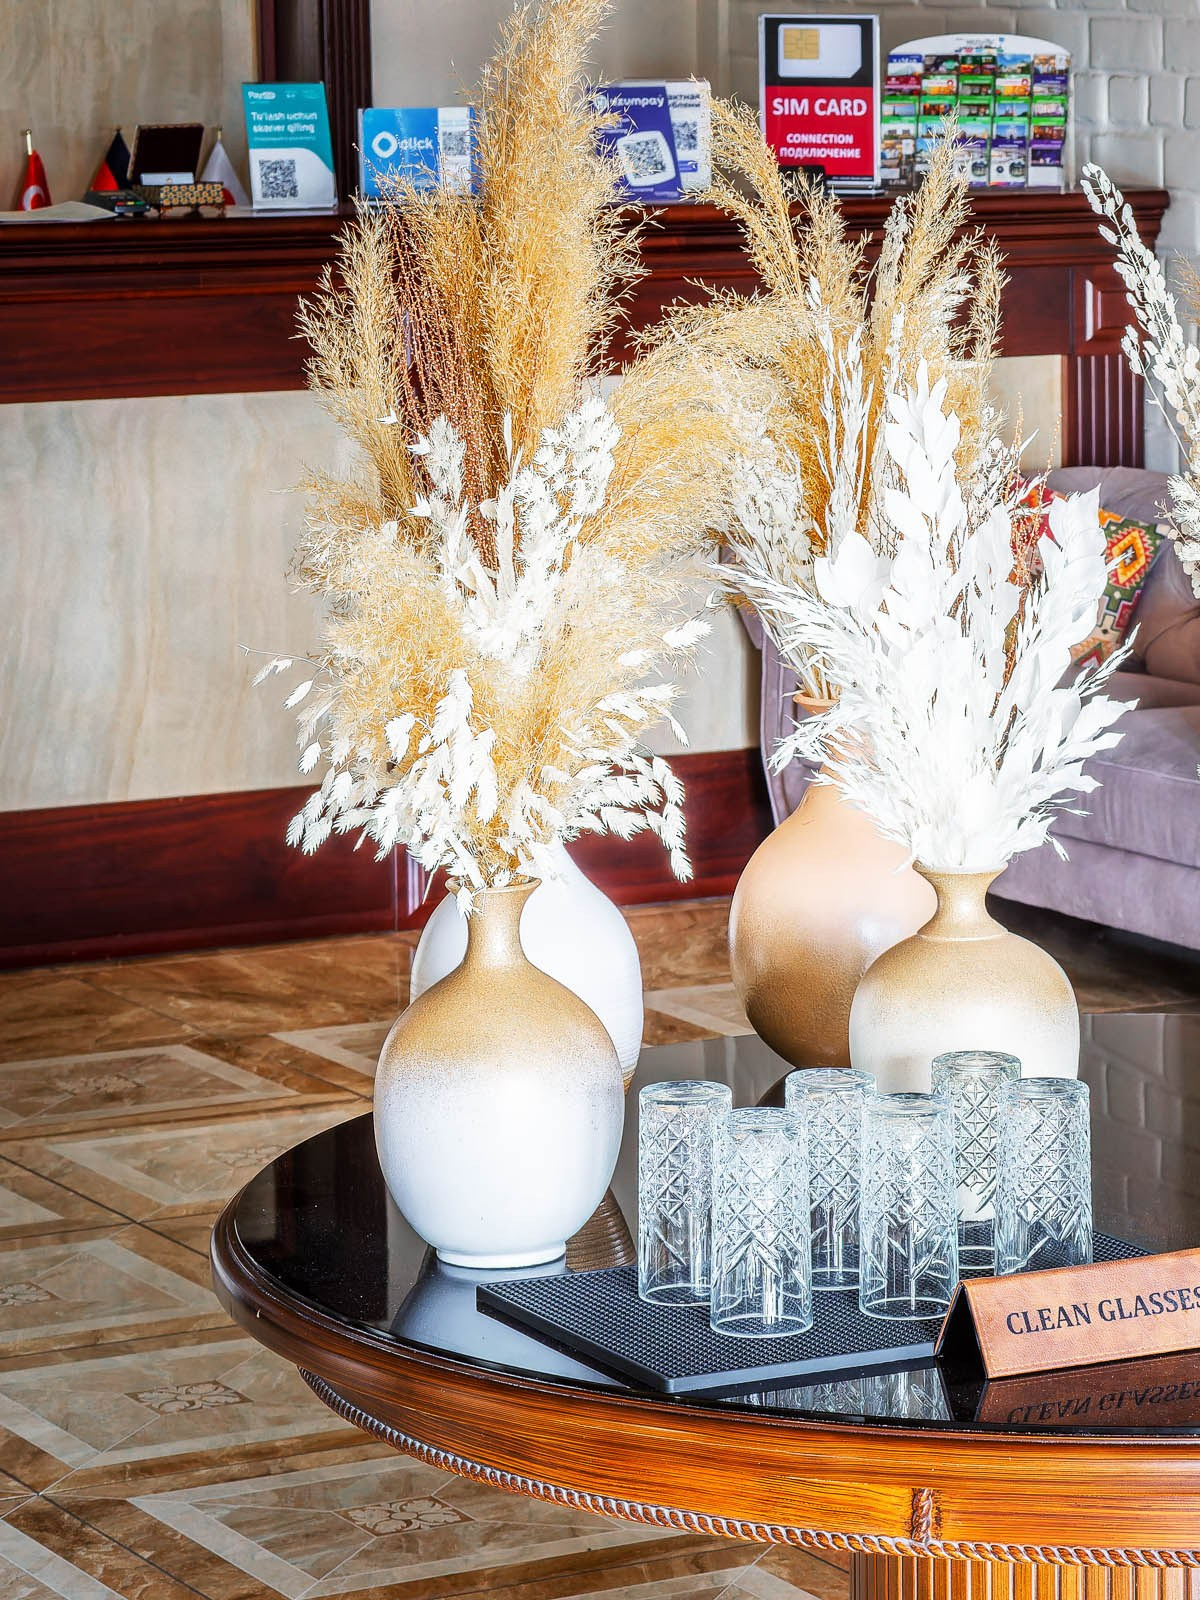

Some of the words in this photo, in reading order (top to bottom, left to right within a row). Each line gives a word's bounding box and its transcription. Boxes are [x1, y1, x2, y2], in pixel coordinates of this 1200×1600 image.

[772, 98, 809, 116] SIM
[814, 98, 867, 116] CARD
[786, 133, 854, 144] CONNECTION
[780, 147, 861, 159] ПОДКЛЮЧЕНИЕ
[1006, 1303, 1091, 1335] CLEAN
